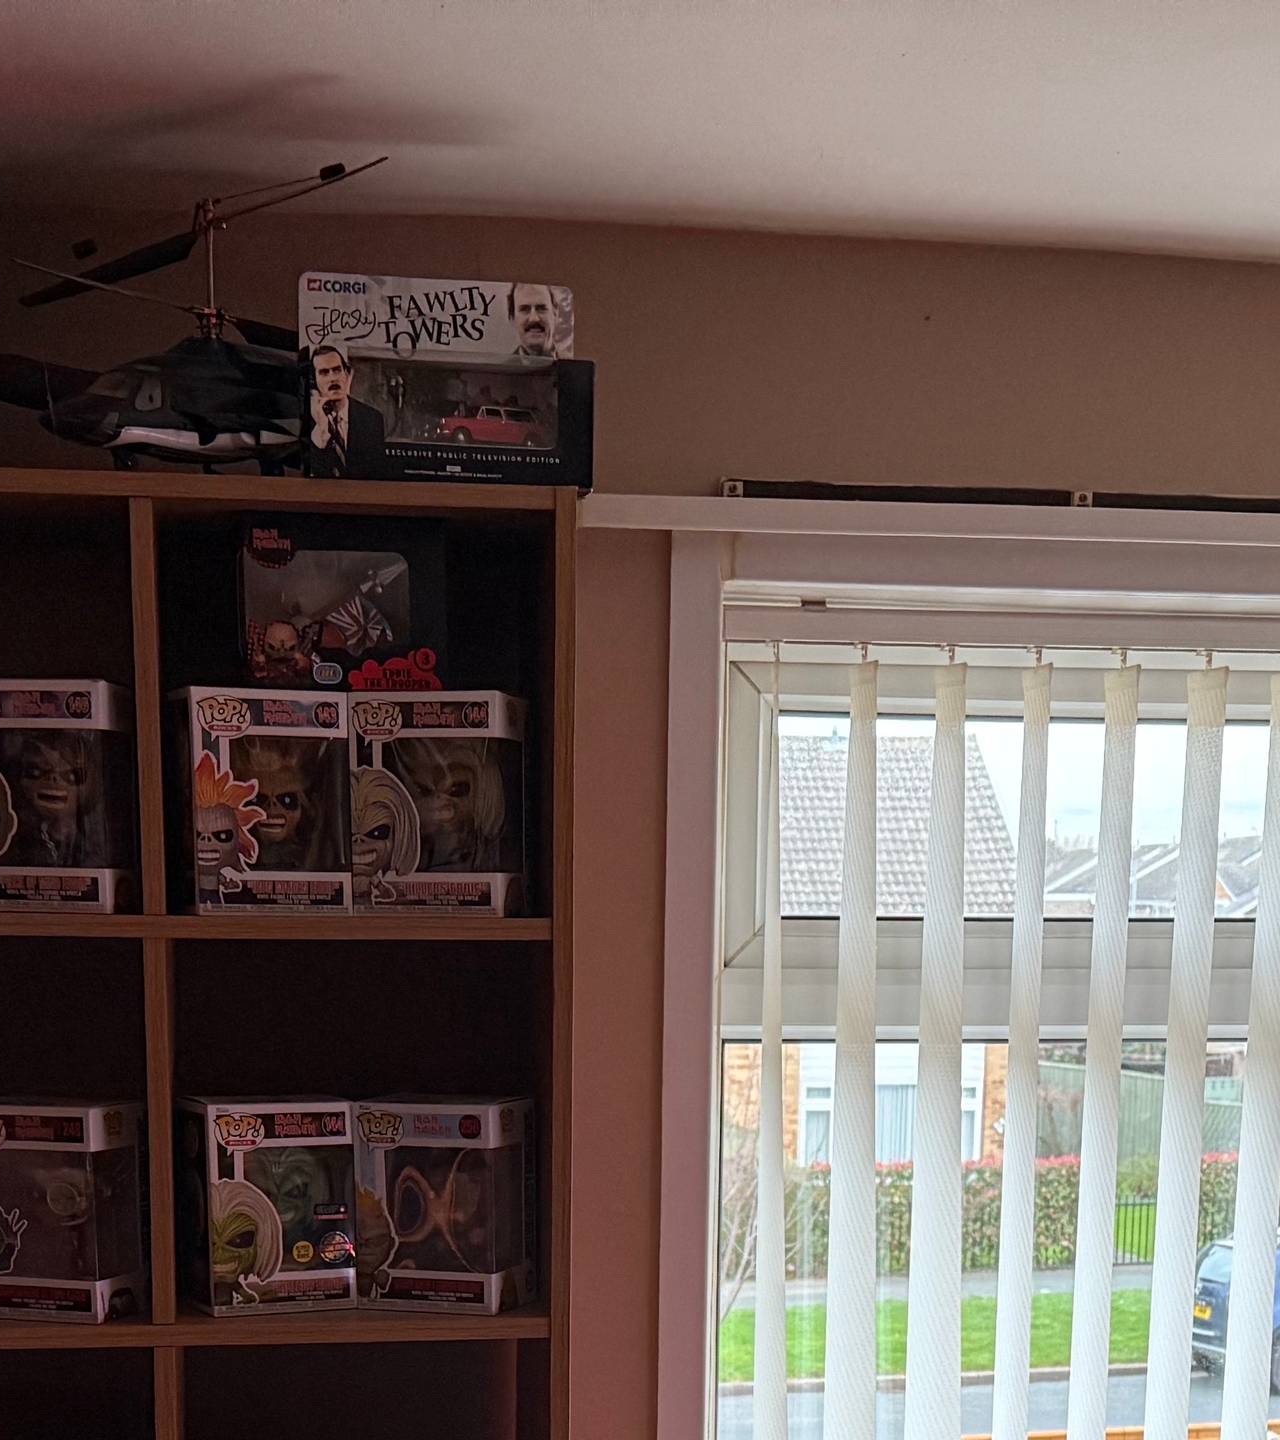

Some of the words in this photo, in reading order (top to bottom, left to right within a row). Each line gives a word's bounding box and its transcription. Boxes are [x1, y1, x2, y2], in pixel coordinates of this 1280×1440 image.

[323, 279, 367, 295] CORGI
[387, 286, 496, 319] FAWLTY
[378, 313, 486, 358] TOWERS
[384, 448, 433, 459] EXCLUSIVE
[437, 451, 468, 460] PUBLIC
[472, 453, 522, 463] TELEVISION
[526, 456, 561, 465] EDITION
[197, 697, 250, 724] POP!
[352, 703, 401, 729] POP!
[214, 1115, 263, 1139] POP!
[358, 1112, 402, 1138] POP!
